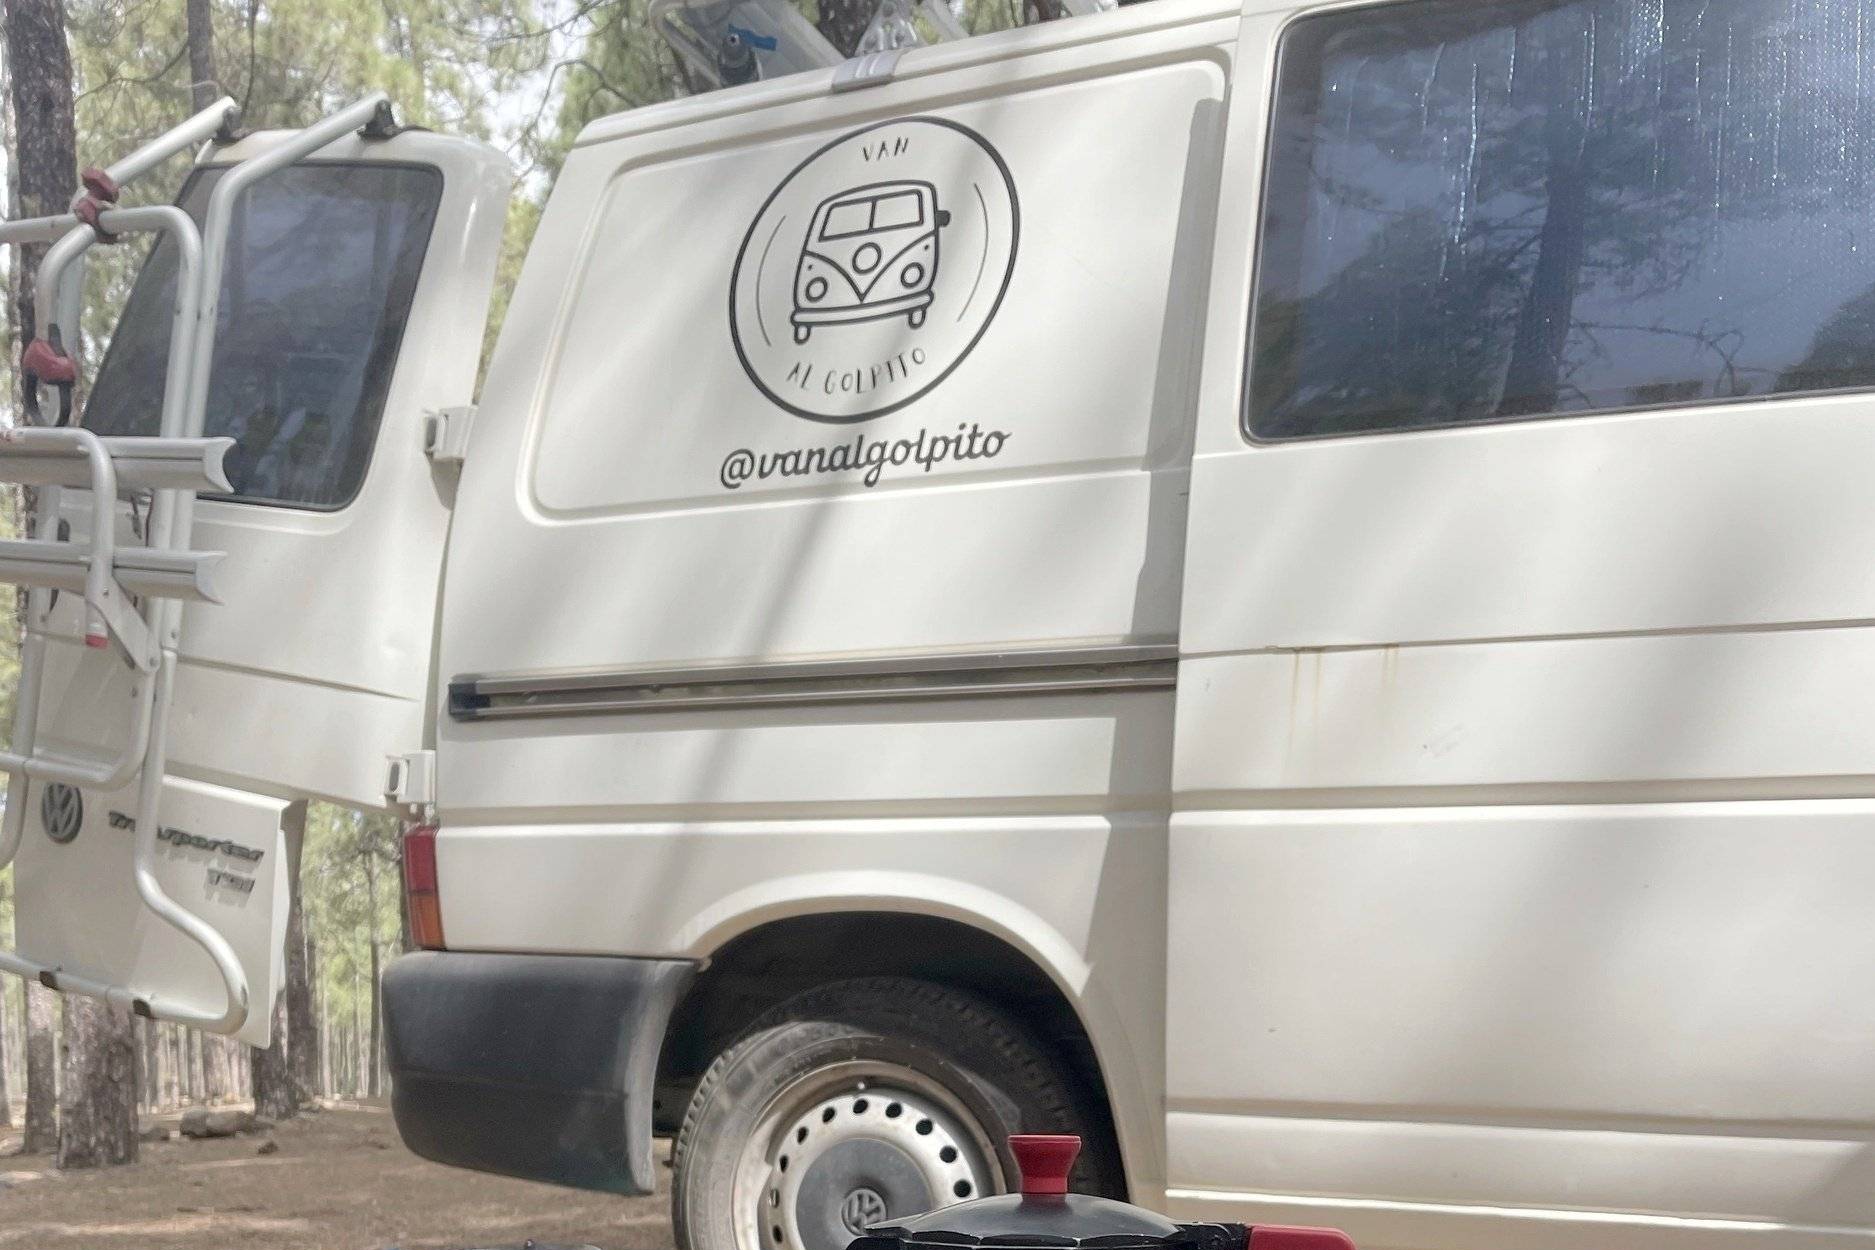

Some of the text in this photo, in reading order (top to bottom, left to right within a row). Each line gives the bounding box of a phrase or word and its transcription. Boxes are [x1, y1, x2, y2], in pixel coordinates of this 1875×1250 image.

[862, 136, 909, 161] VAN
[824, 348, 926, 395] GOLPITO
[720, 422, 1012, 490] @vanalgolpito
